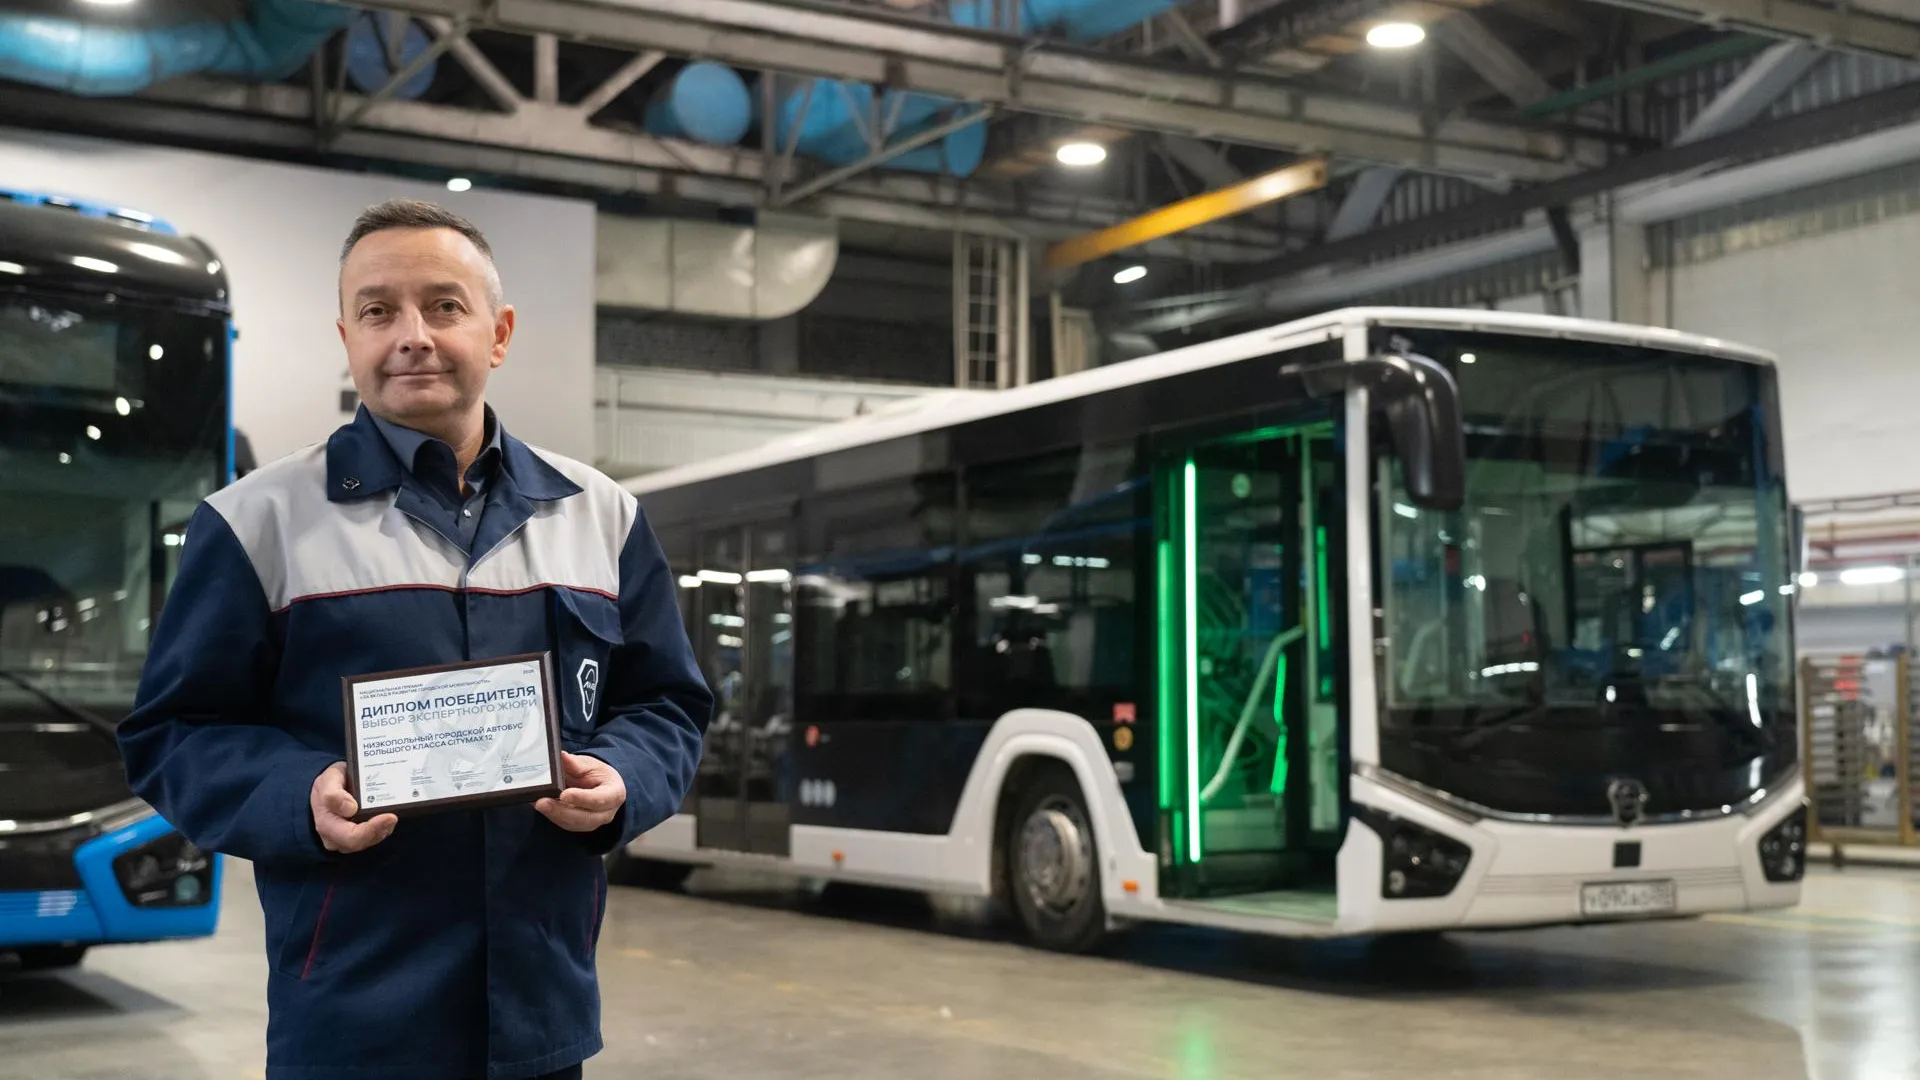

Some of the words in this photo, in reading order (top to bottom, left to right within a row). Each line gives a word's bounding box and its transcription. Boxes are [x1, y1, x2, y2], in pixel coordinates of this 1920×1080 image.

[361, 699, 431, 719] ДИПЛОМ
[435, 685, 536, 708] ПОБЕДИТЕЛЯ
[362, 715, 405, 729] ВЫБОР
[408, 703, 495, 723] ЭКСПЕРТНОГО
[498, 698, 537, 711] ЖЮРИ
[363, 733, 434, 749] НИЗКОПОЛЬНЫЙ
[435, 726, 484, 741] ГОРОДСКОЙ
[486, 722, 523, 733] АВТОБУС
[364, 745, 411, 757] БОЛЬШОГО
[412, 740, 446, 750] КЛАССА
[447, 735, 484, 746] CITYMAX
